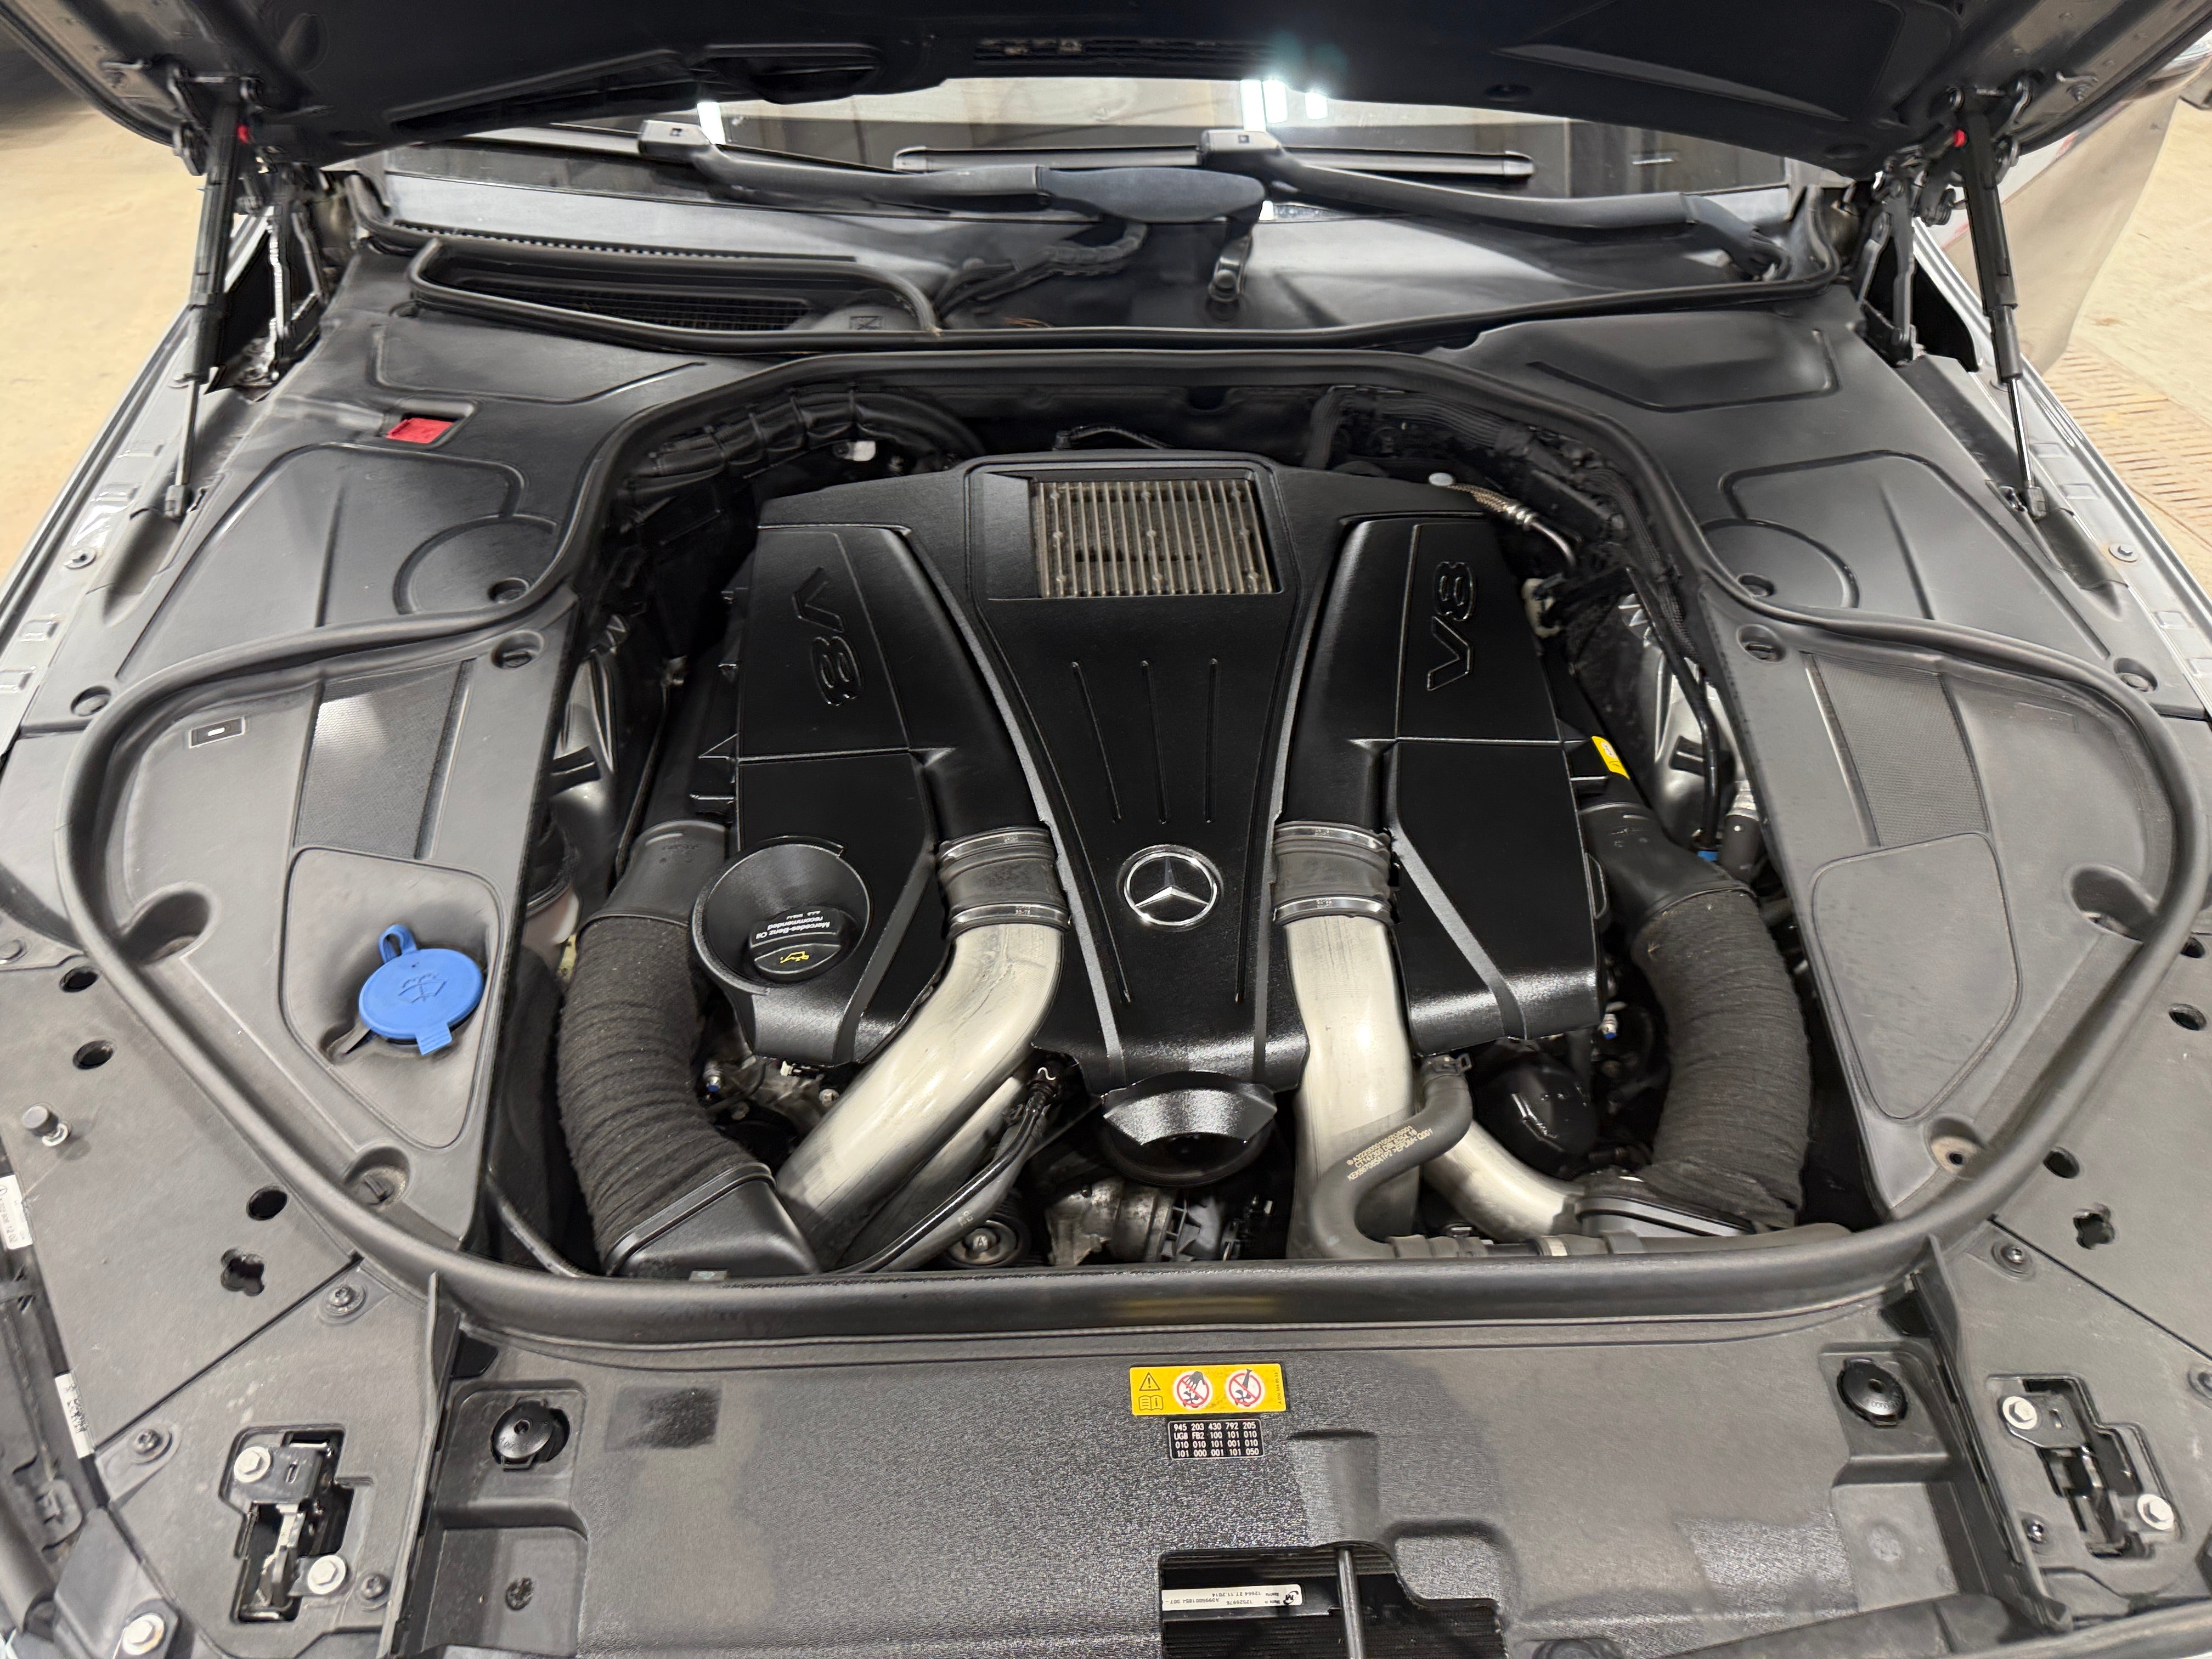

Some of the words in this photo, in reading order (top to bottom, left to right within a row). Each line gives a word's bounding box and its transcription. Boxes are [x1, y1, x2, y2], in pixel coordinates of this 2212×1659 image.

[1427, 560, 1476, 691] V8
[792, 566, 864, 707] V8
[768, 916, 823, 932] recommended
[769, 922, 831, 936] Mercedes-Benz
[755, 932, 768, 940] Oil
[1174, 1423, 1187, 1431] 945
[1174, 1432, 1188, 1440] UG8
[1192, 1431, 1205, 1440] FB2
[1175, 1441, 1189, 1449] 010
